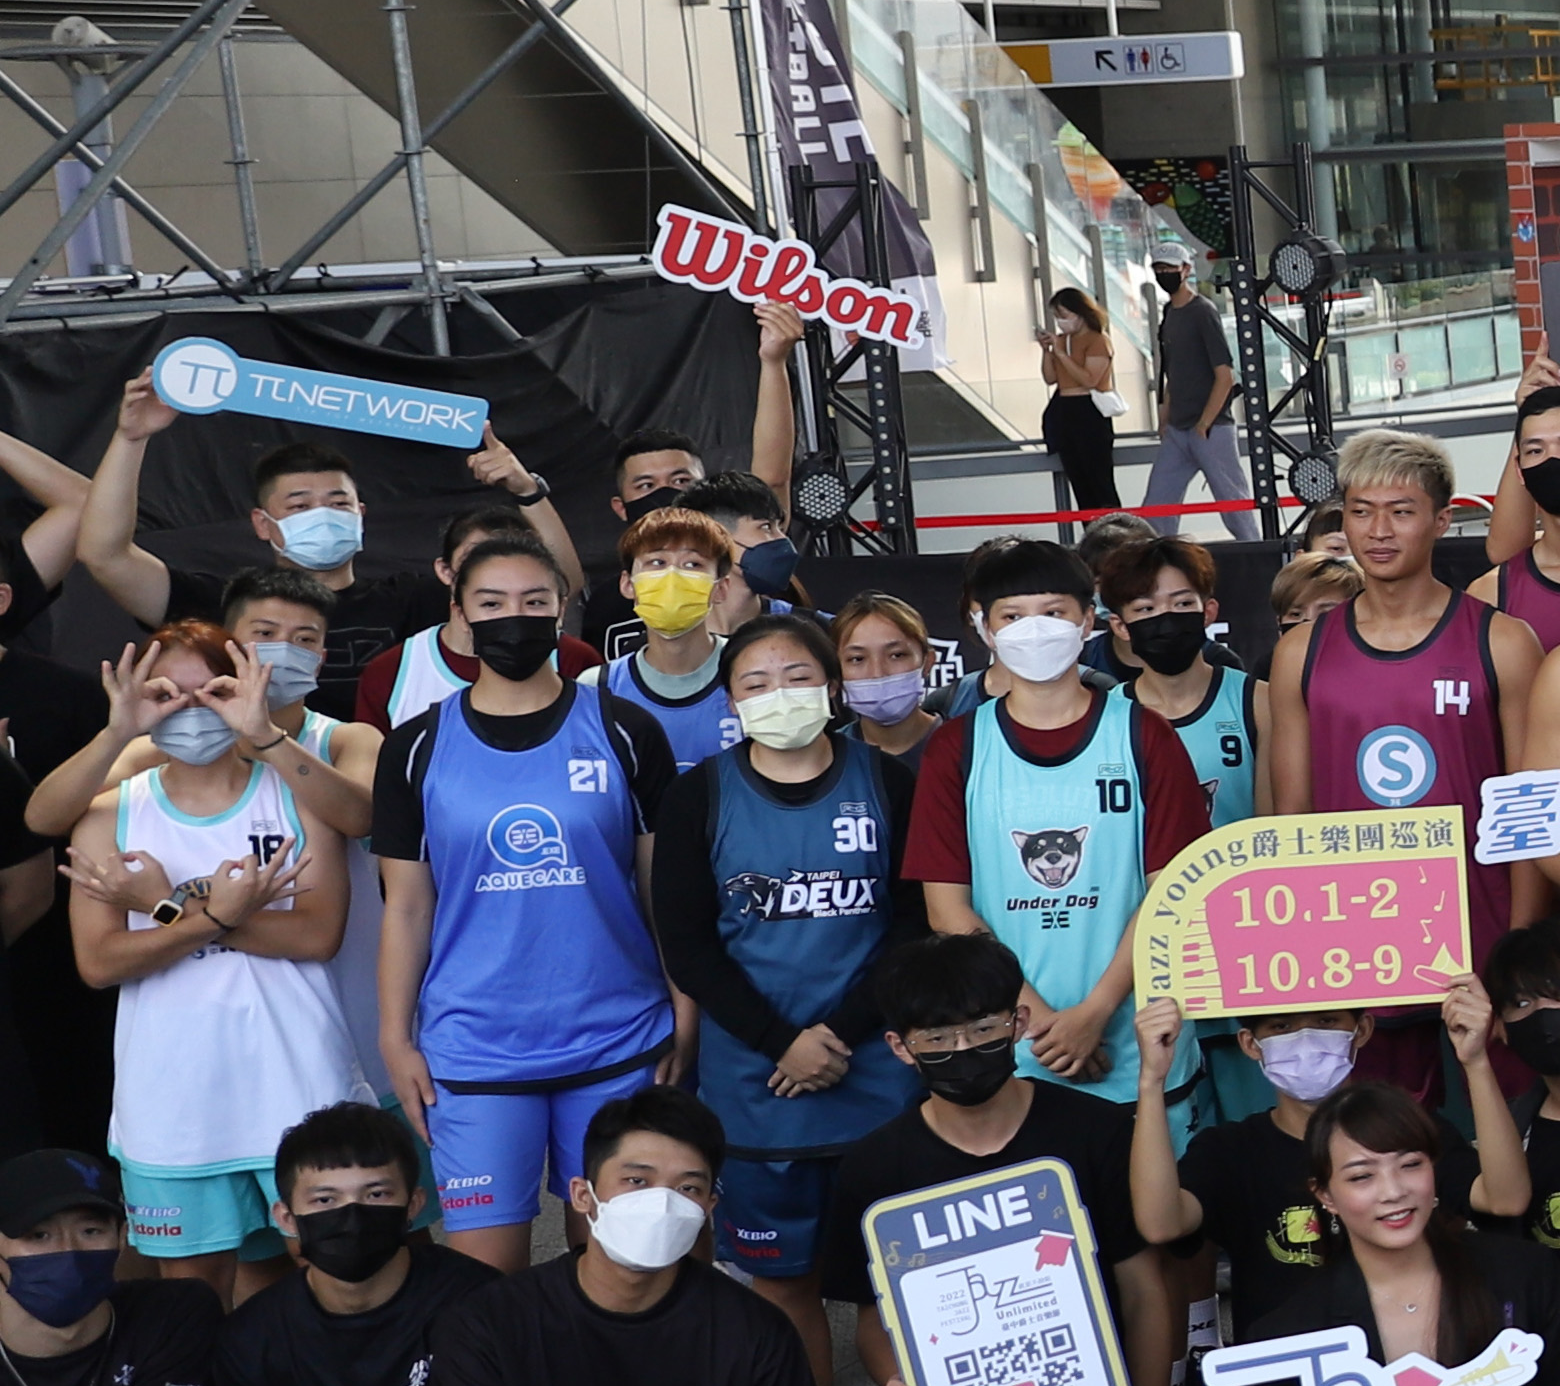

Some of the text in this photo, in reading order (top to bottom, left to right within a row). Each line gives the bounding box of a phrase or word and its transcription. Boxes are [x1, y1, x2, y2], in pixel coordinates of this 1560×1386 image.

[660, 213, 911, 342] Wilson
[1433, 680, 1471, 716] 14
[1220, 734, 1242, 767] 9
[566, 759, 608, 794] 21
[1094, 778, 1132, 814] 10
[832, 816, 878, 853] 30
[474, 867, 587, 893] AQUECARE
[806, 870, 839, 882] TAIPEI
[780, 875, 877, 914] DEUX
[1006, 894, 1099, 913] Under Dog
[1234, 875, 1399, 928] 10.1-2
[1238, 942, 1403, 996] 10.8-9
[911, 1184, 1033, 1251] LINE
[994, 1295, 1059, 1322] Unlimited
